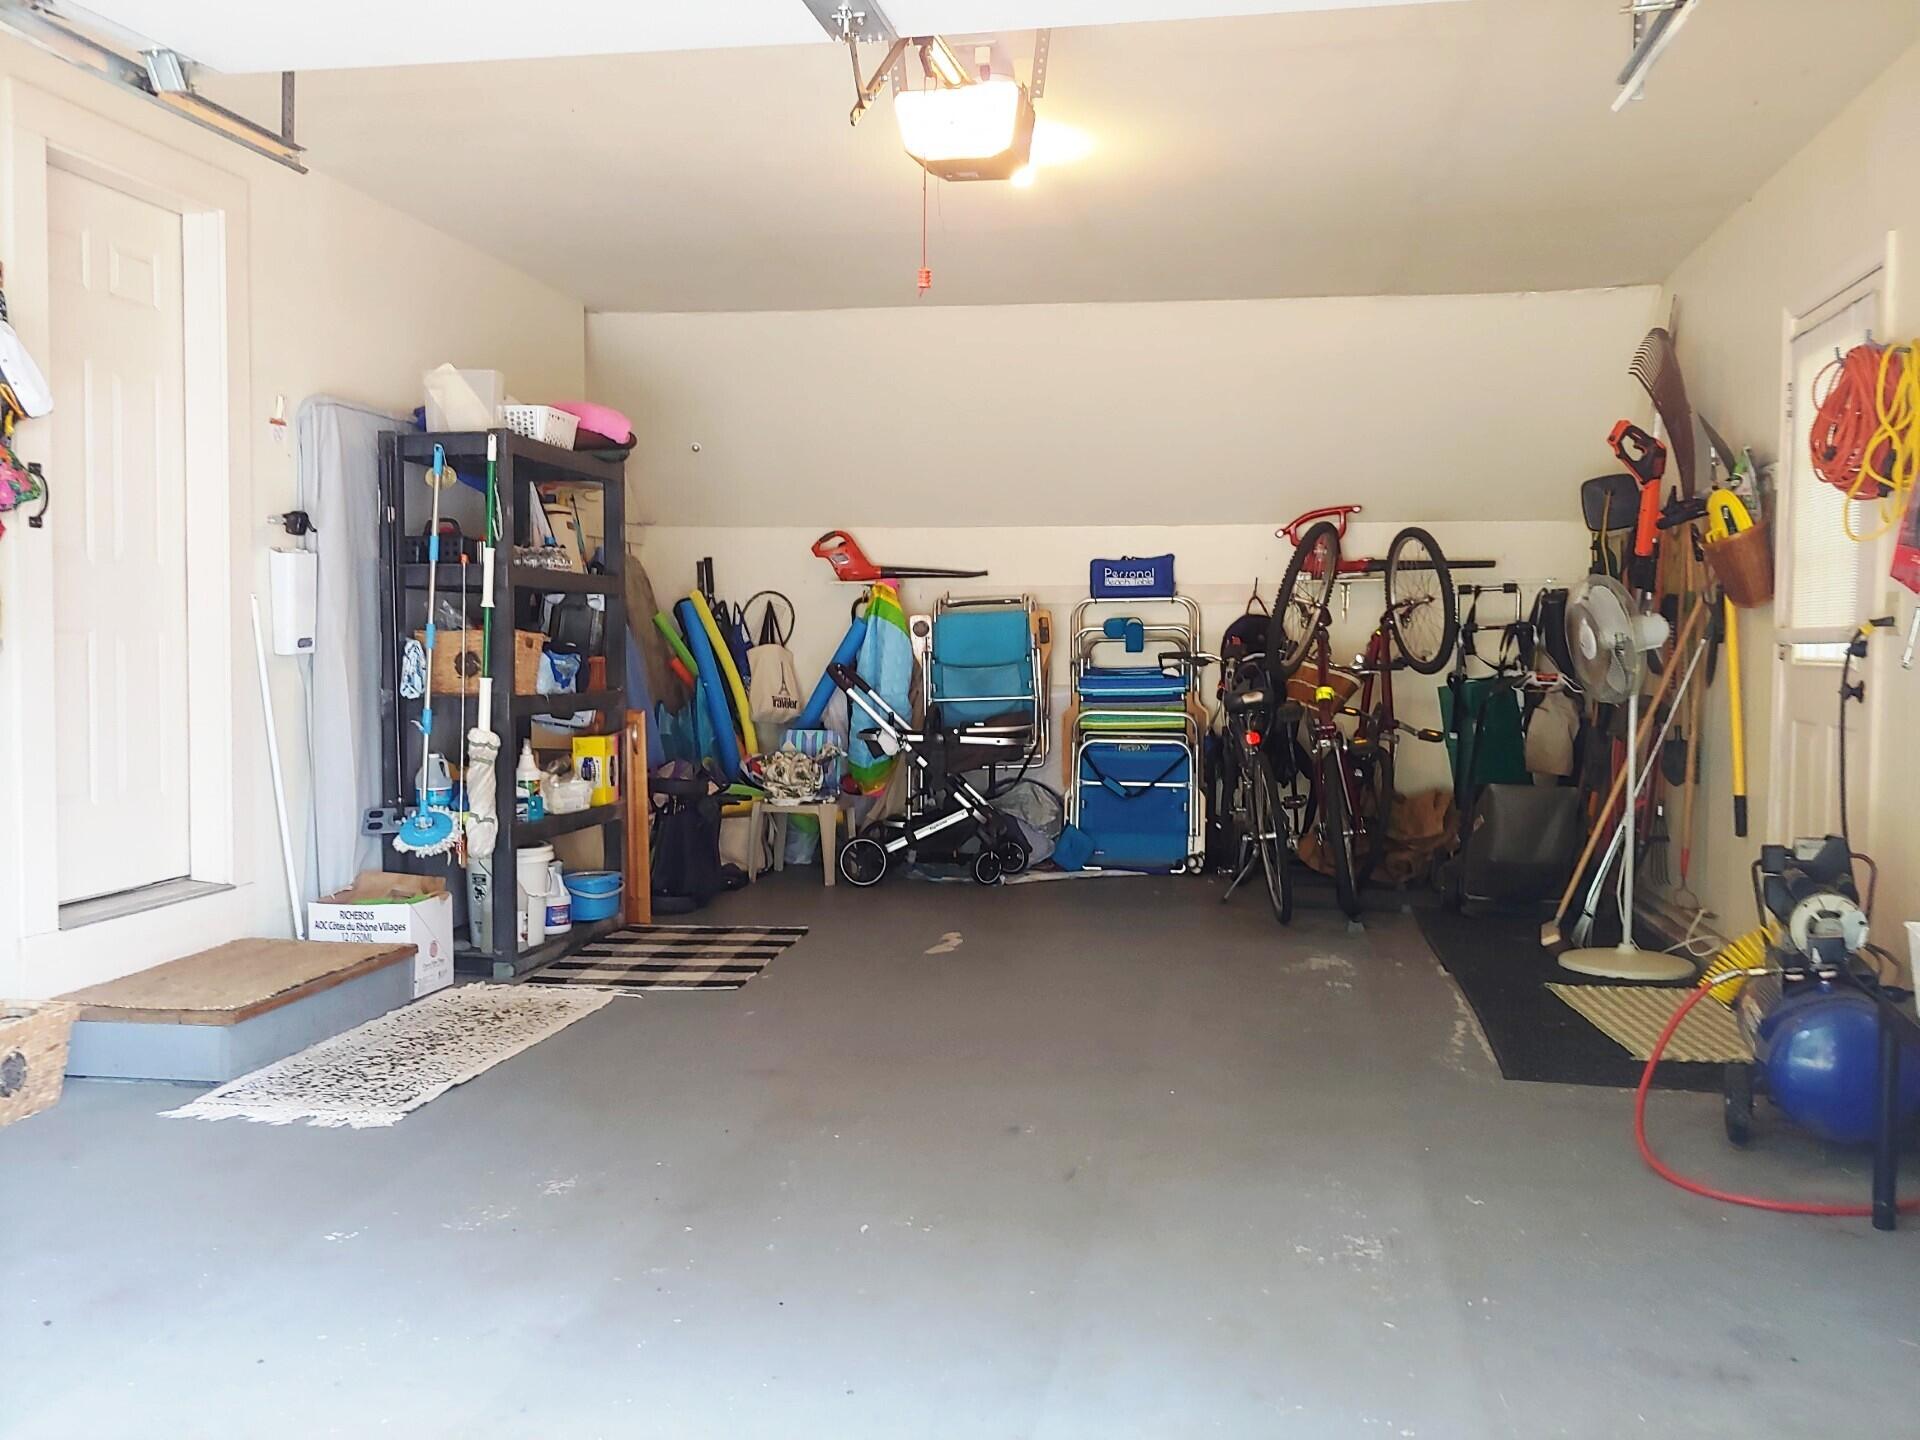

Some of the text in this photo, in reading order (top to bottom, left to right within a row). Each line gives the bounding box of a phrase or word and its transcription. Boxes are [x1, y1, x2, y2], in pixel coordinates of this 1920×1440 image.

[1104, 568, 1154, 578] Personal
[340, 911, 375, 920] RICHEBOIS
[346, 921, 355, 931] du
[378, 922, 407, 933] Villages
